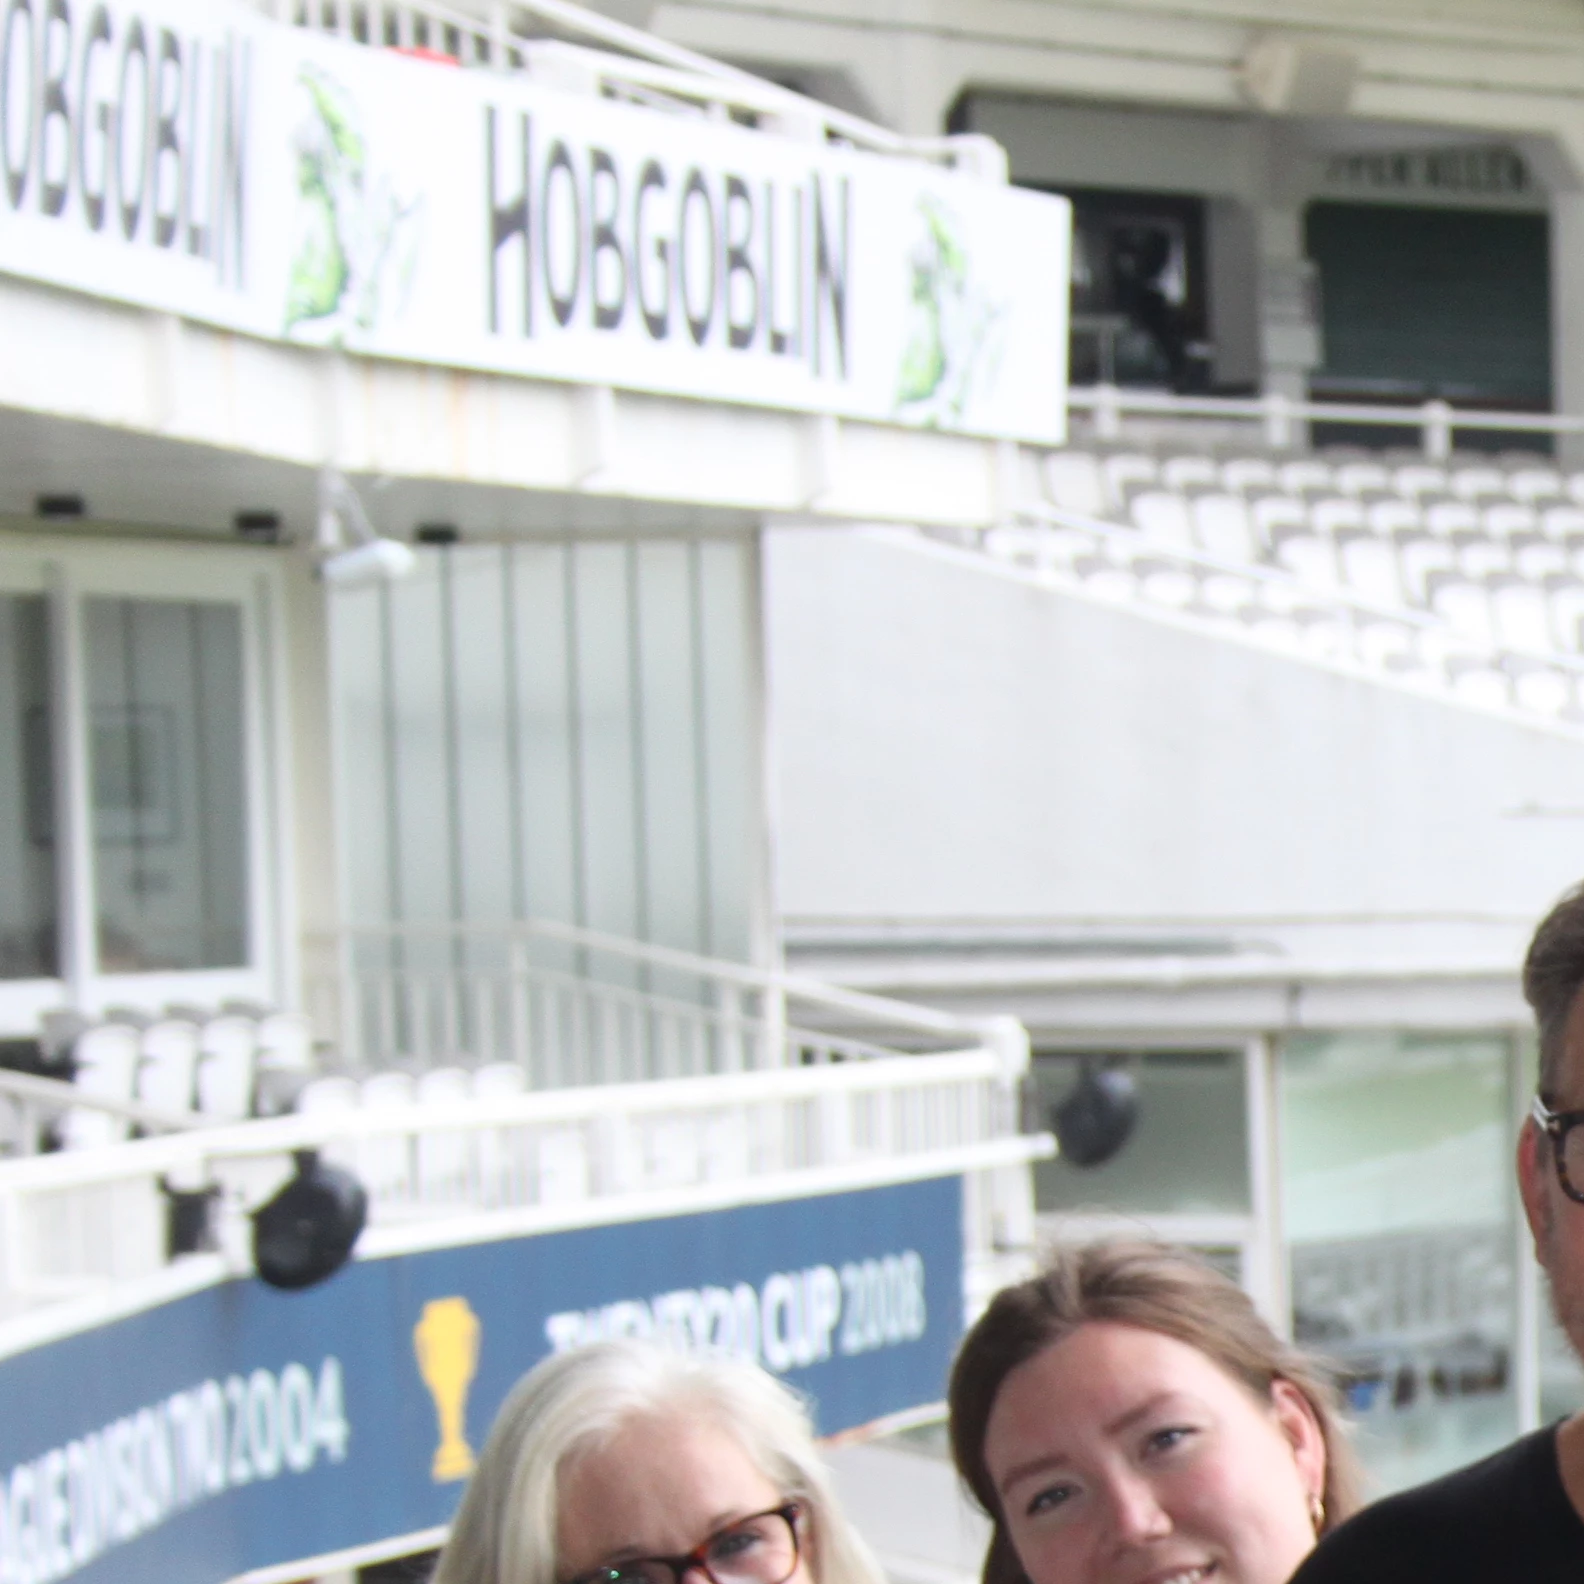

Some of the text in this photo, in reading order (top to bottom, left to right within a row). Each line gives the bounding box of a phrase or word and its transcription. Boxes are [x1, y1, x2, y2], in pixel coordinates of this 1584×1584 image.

[1, 0, 251, 290] OBGOBLIN
[484, 103, 852, 381] HOBGOBLIN
[761, 1264, 842, 1373] CUP
[838, 1249, 926, 1356] 2008
[223, 1355, 351, 1486] 2004
